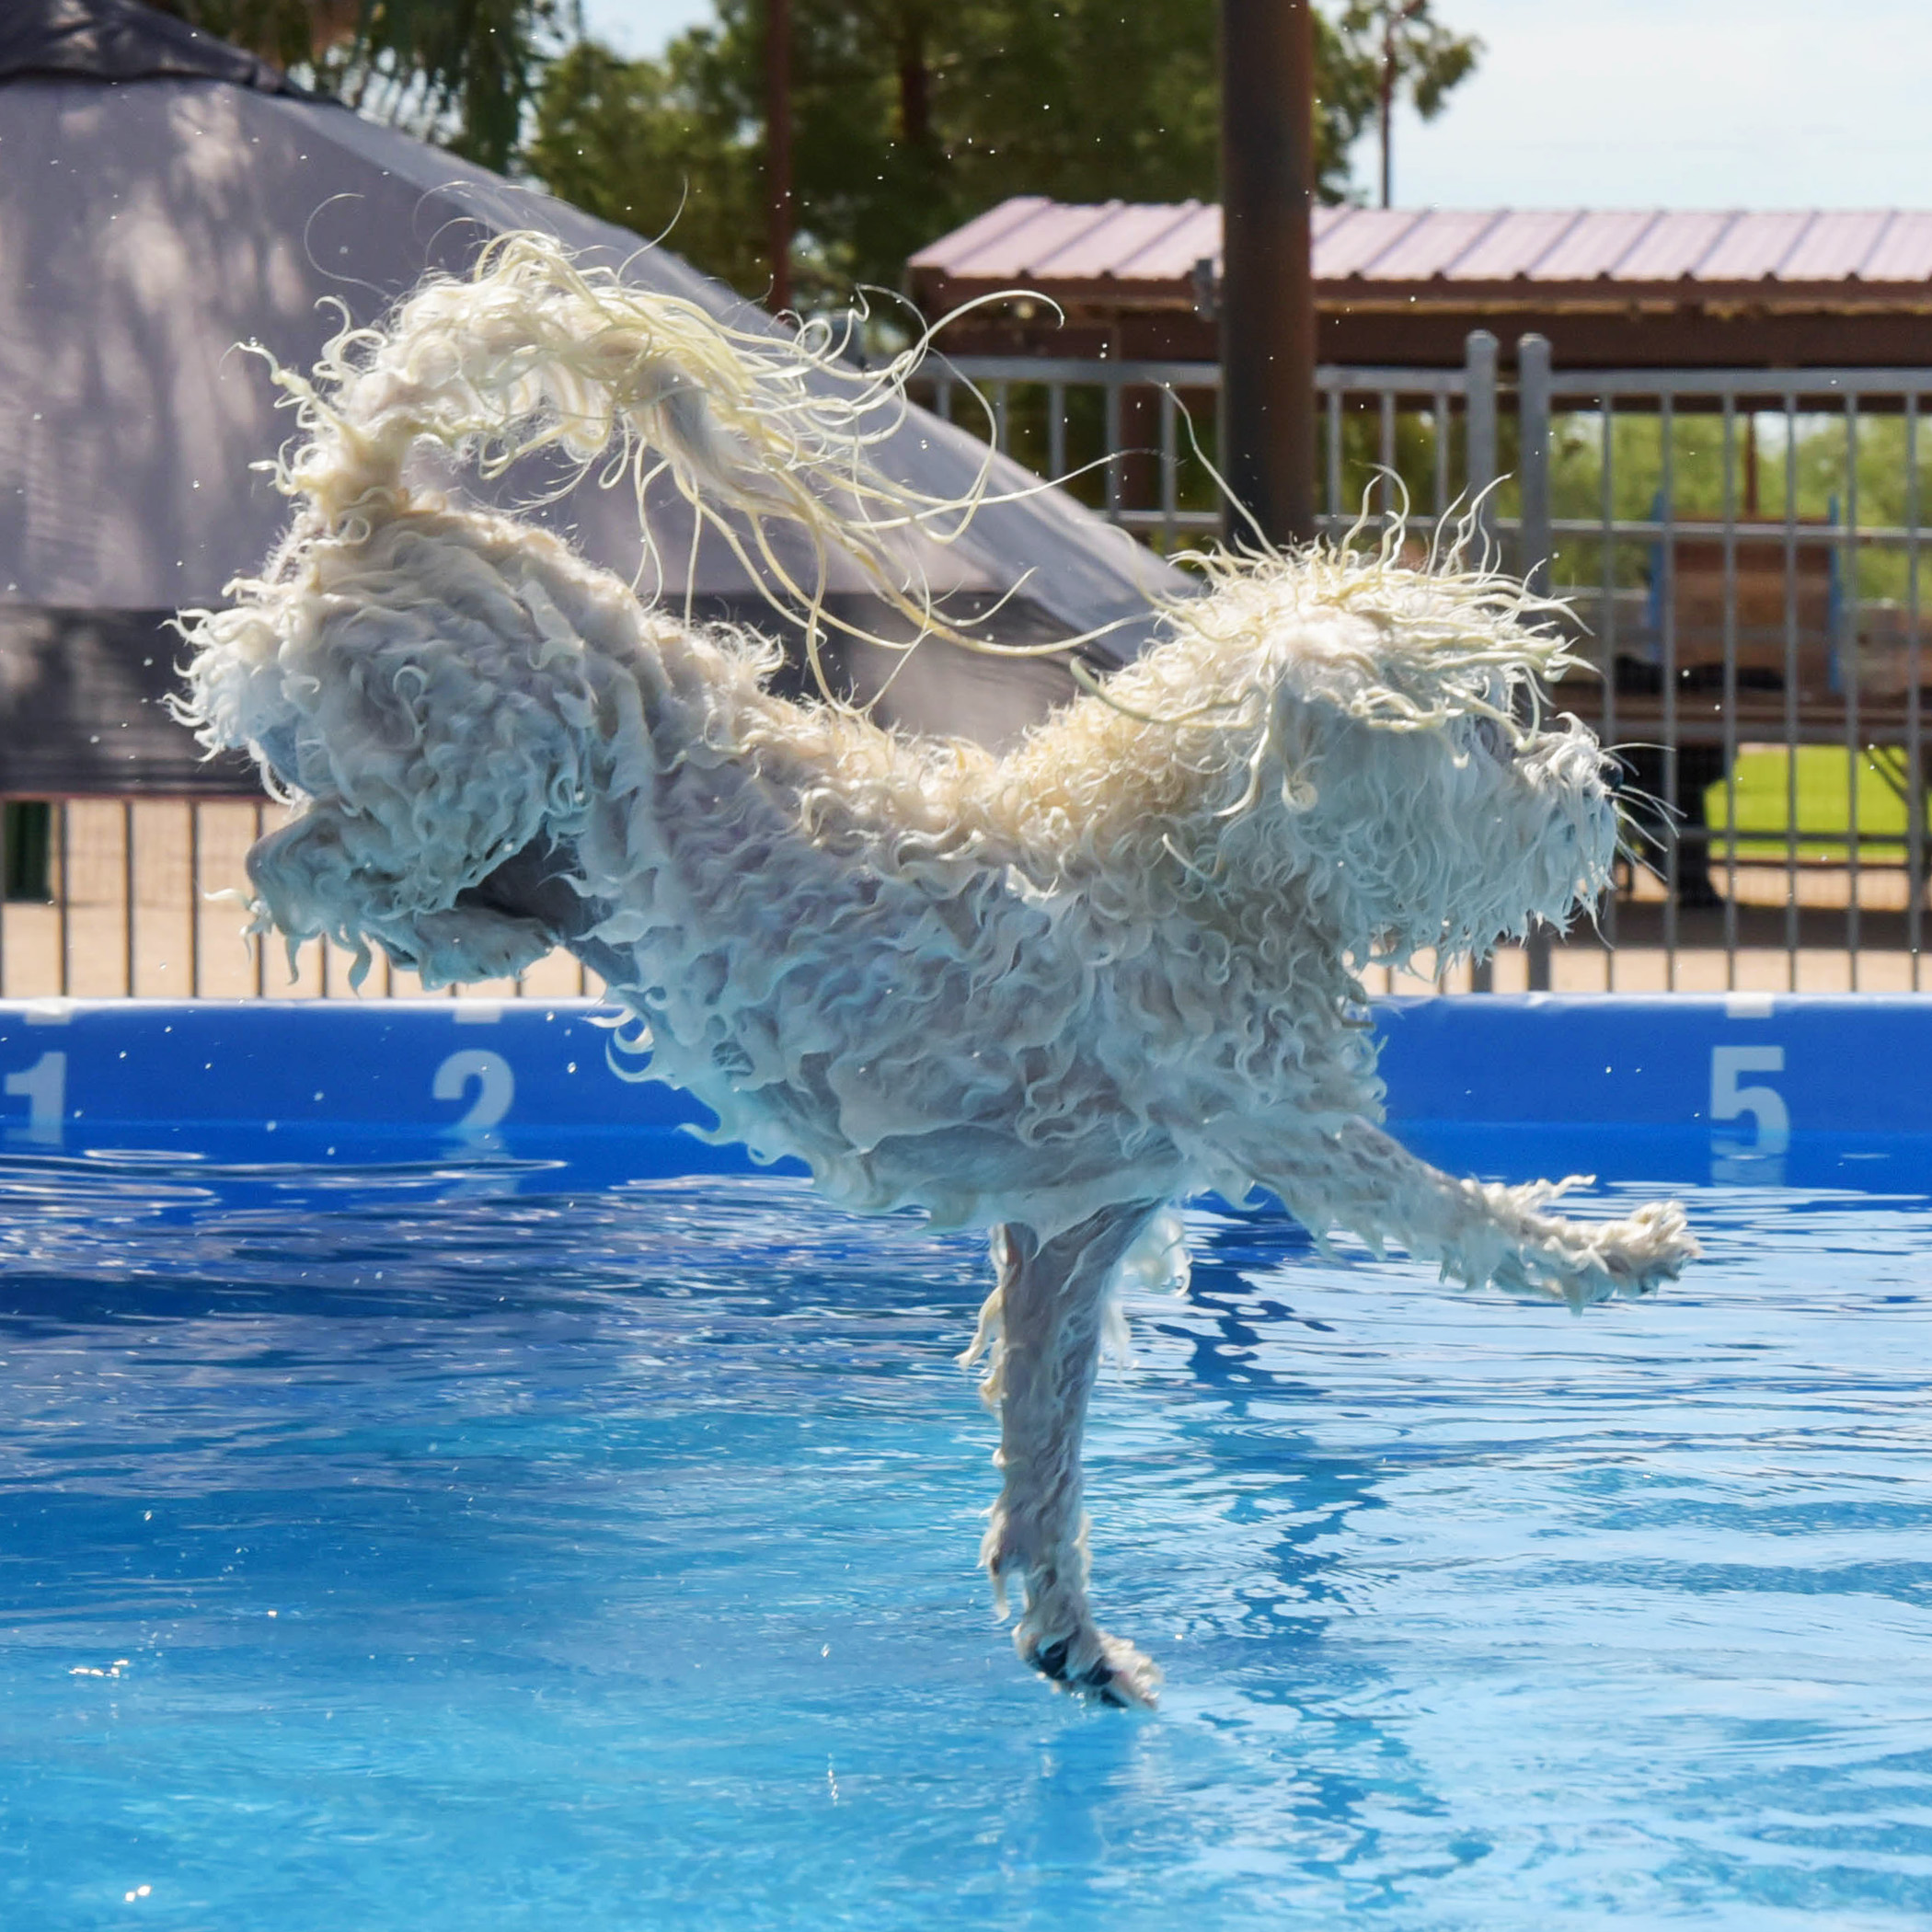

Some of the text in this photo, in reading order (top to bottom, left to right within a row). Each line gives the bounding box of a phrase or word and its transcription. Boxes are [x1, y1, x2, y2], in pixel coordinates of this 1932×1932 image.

[4, 1052, 66, 1137] 1
[432, 1049, 515, 1135] 2
[1710, 1045, 1790, 1148] 5
